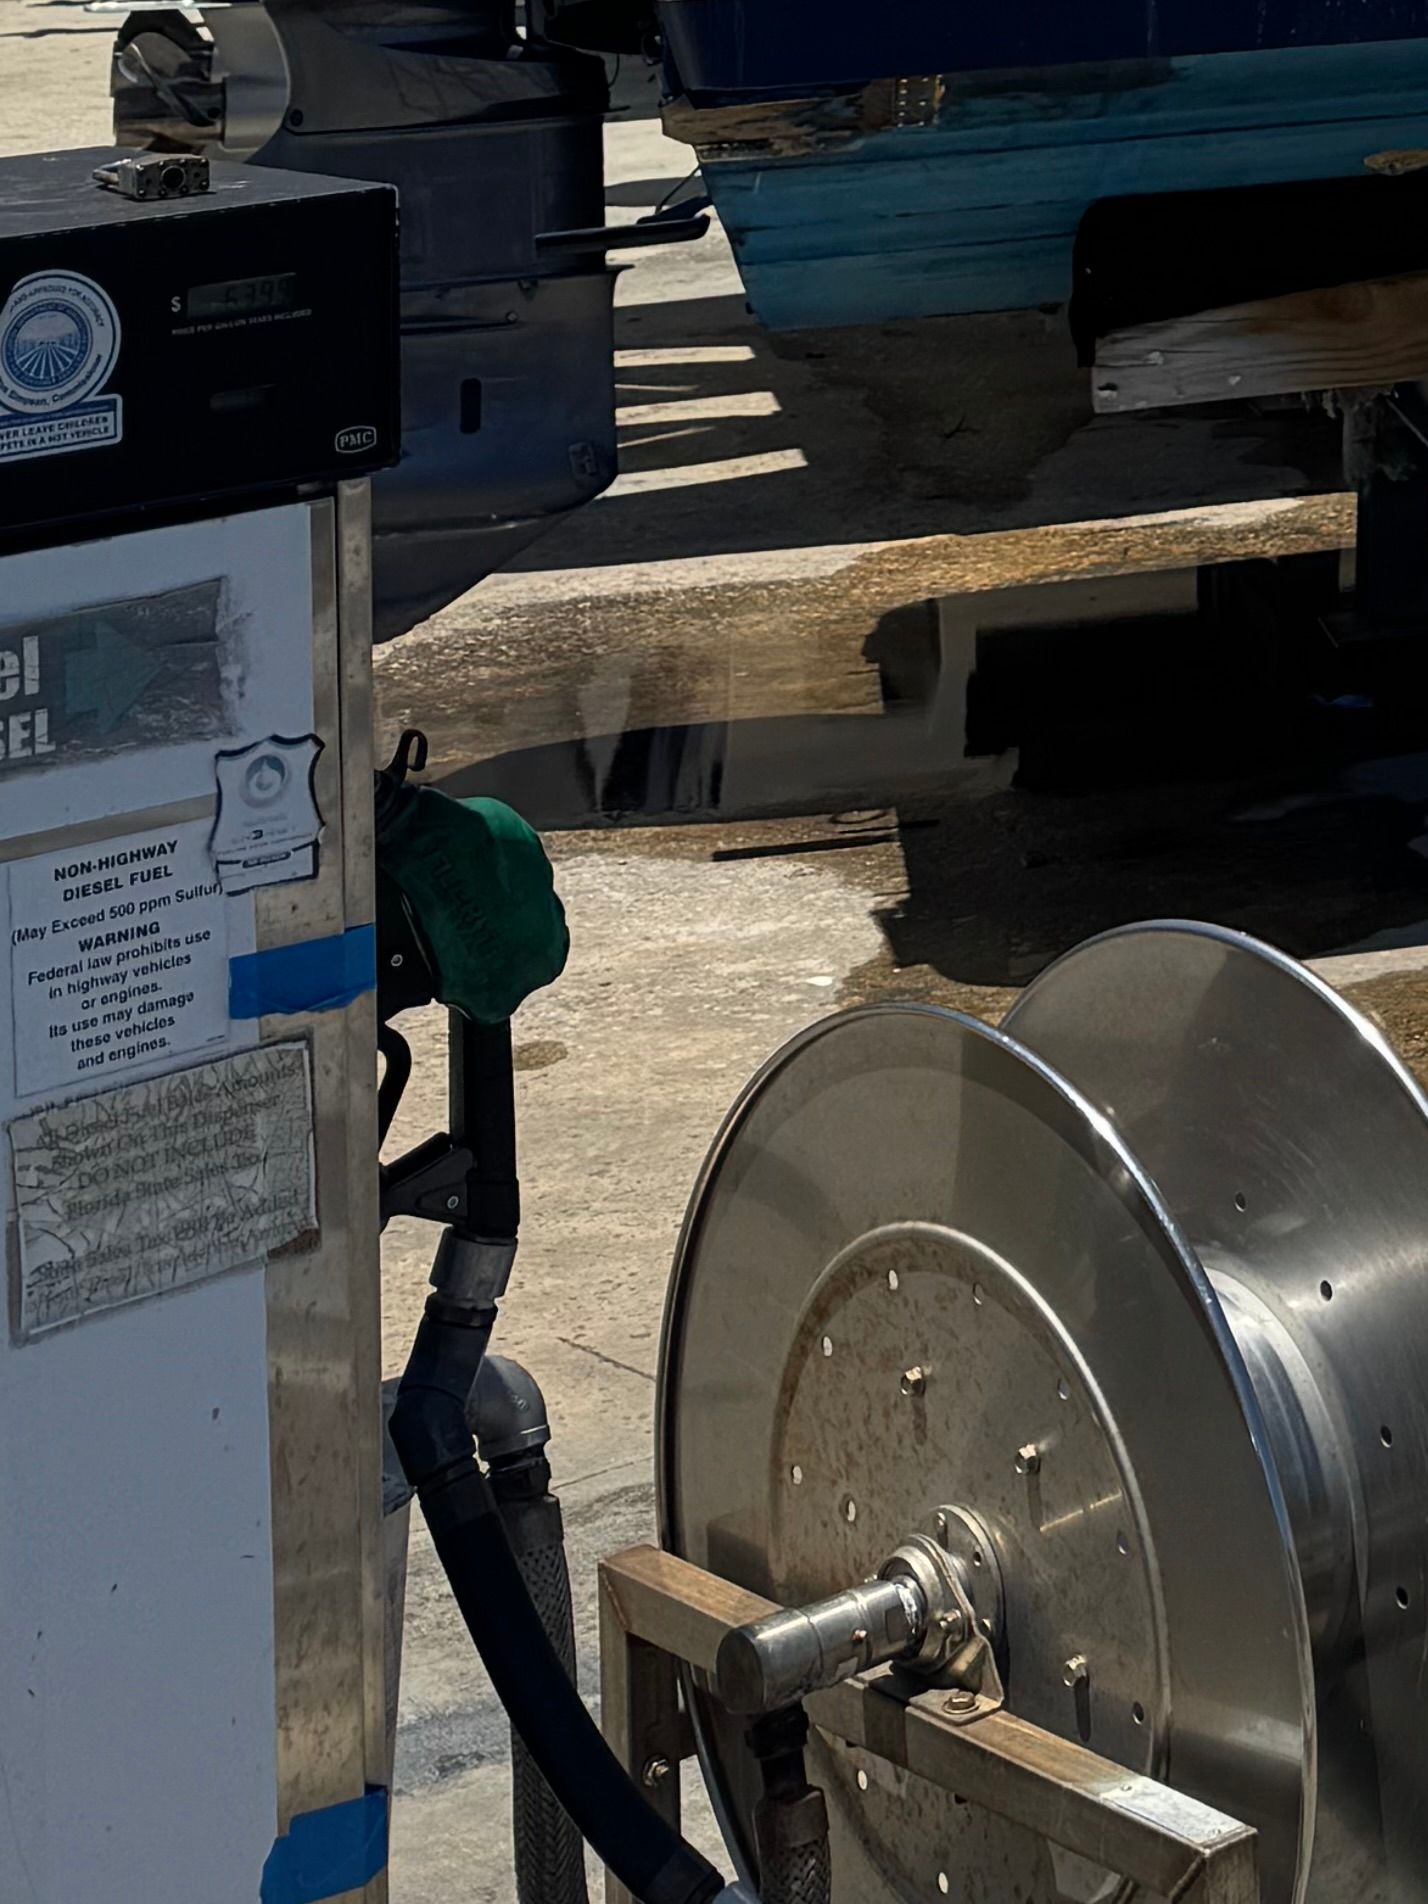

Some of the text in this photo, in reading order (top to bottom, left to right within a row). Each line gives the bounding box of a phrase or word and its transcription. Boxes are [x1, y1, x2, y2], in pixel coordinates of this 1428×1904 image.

[171, 296, 181, 312] $
[53, 840, 179, 882] NON-HIGHWAY
[62, 865, 173, 902] DIESEL FUEL
[11, 882, 224, 947] (May Exceed 500 ppm Sulfur)
[78, 921, 161, 953] WARNING
[28, 928, 211, 986] Federal law prohibits use
[49, 953, 192, 999] in highway vehicles
[80, 982, 163, 1010] or engines.
[49, 991, 194, 1039] Its use may damage
[71, 1015, 176, 1053] these vehicles
[77, 1036, 171, 1071] and engines.
[113, 1151, 159, 1181] NOT
